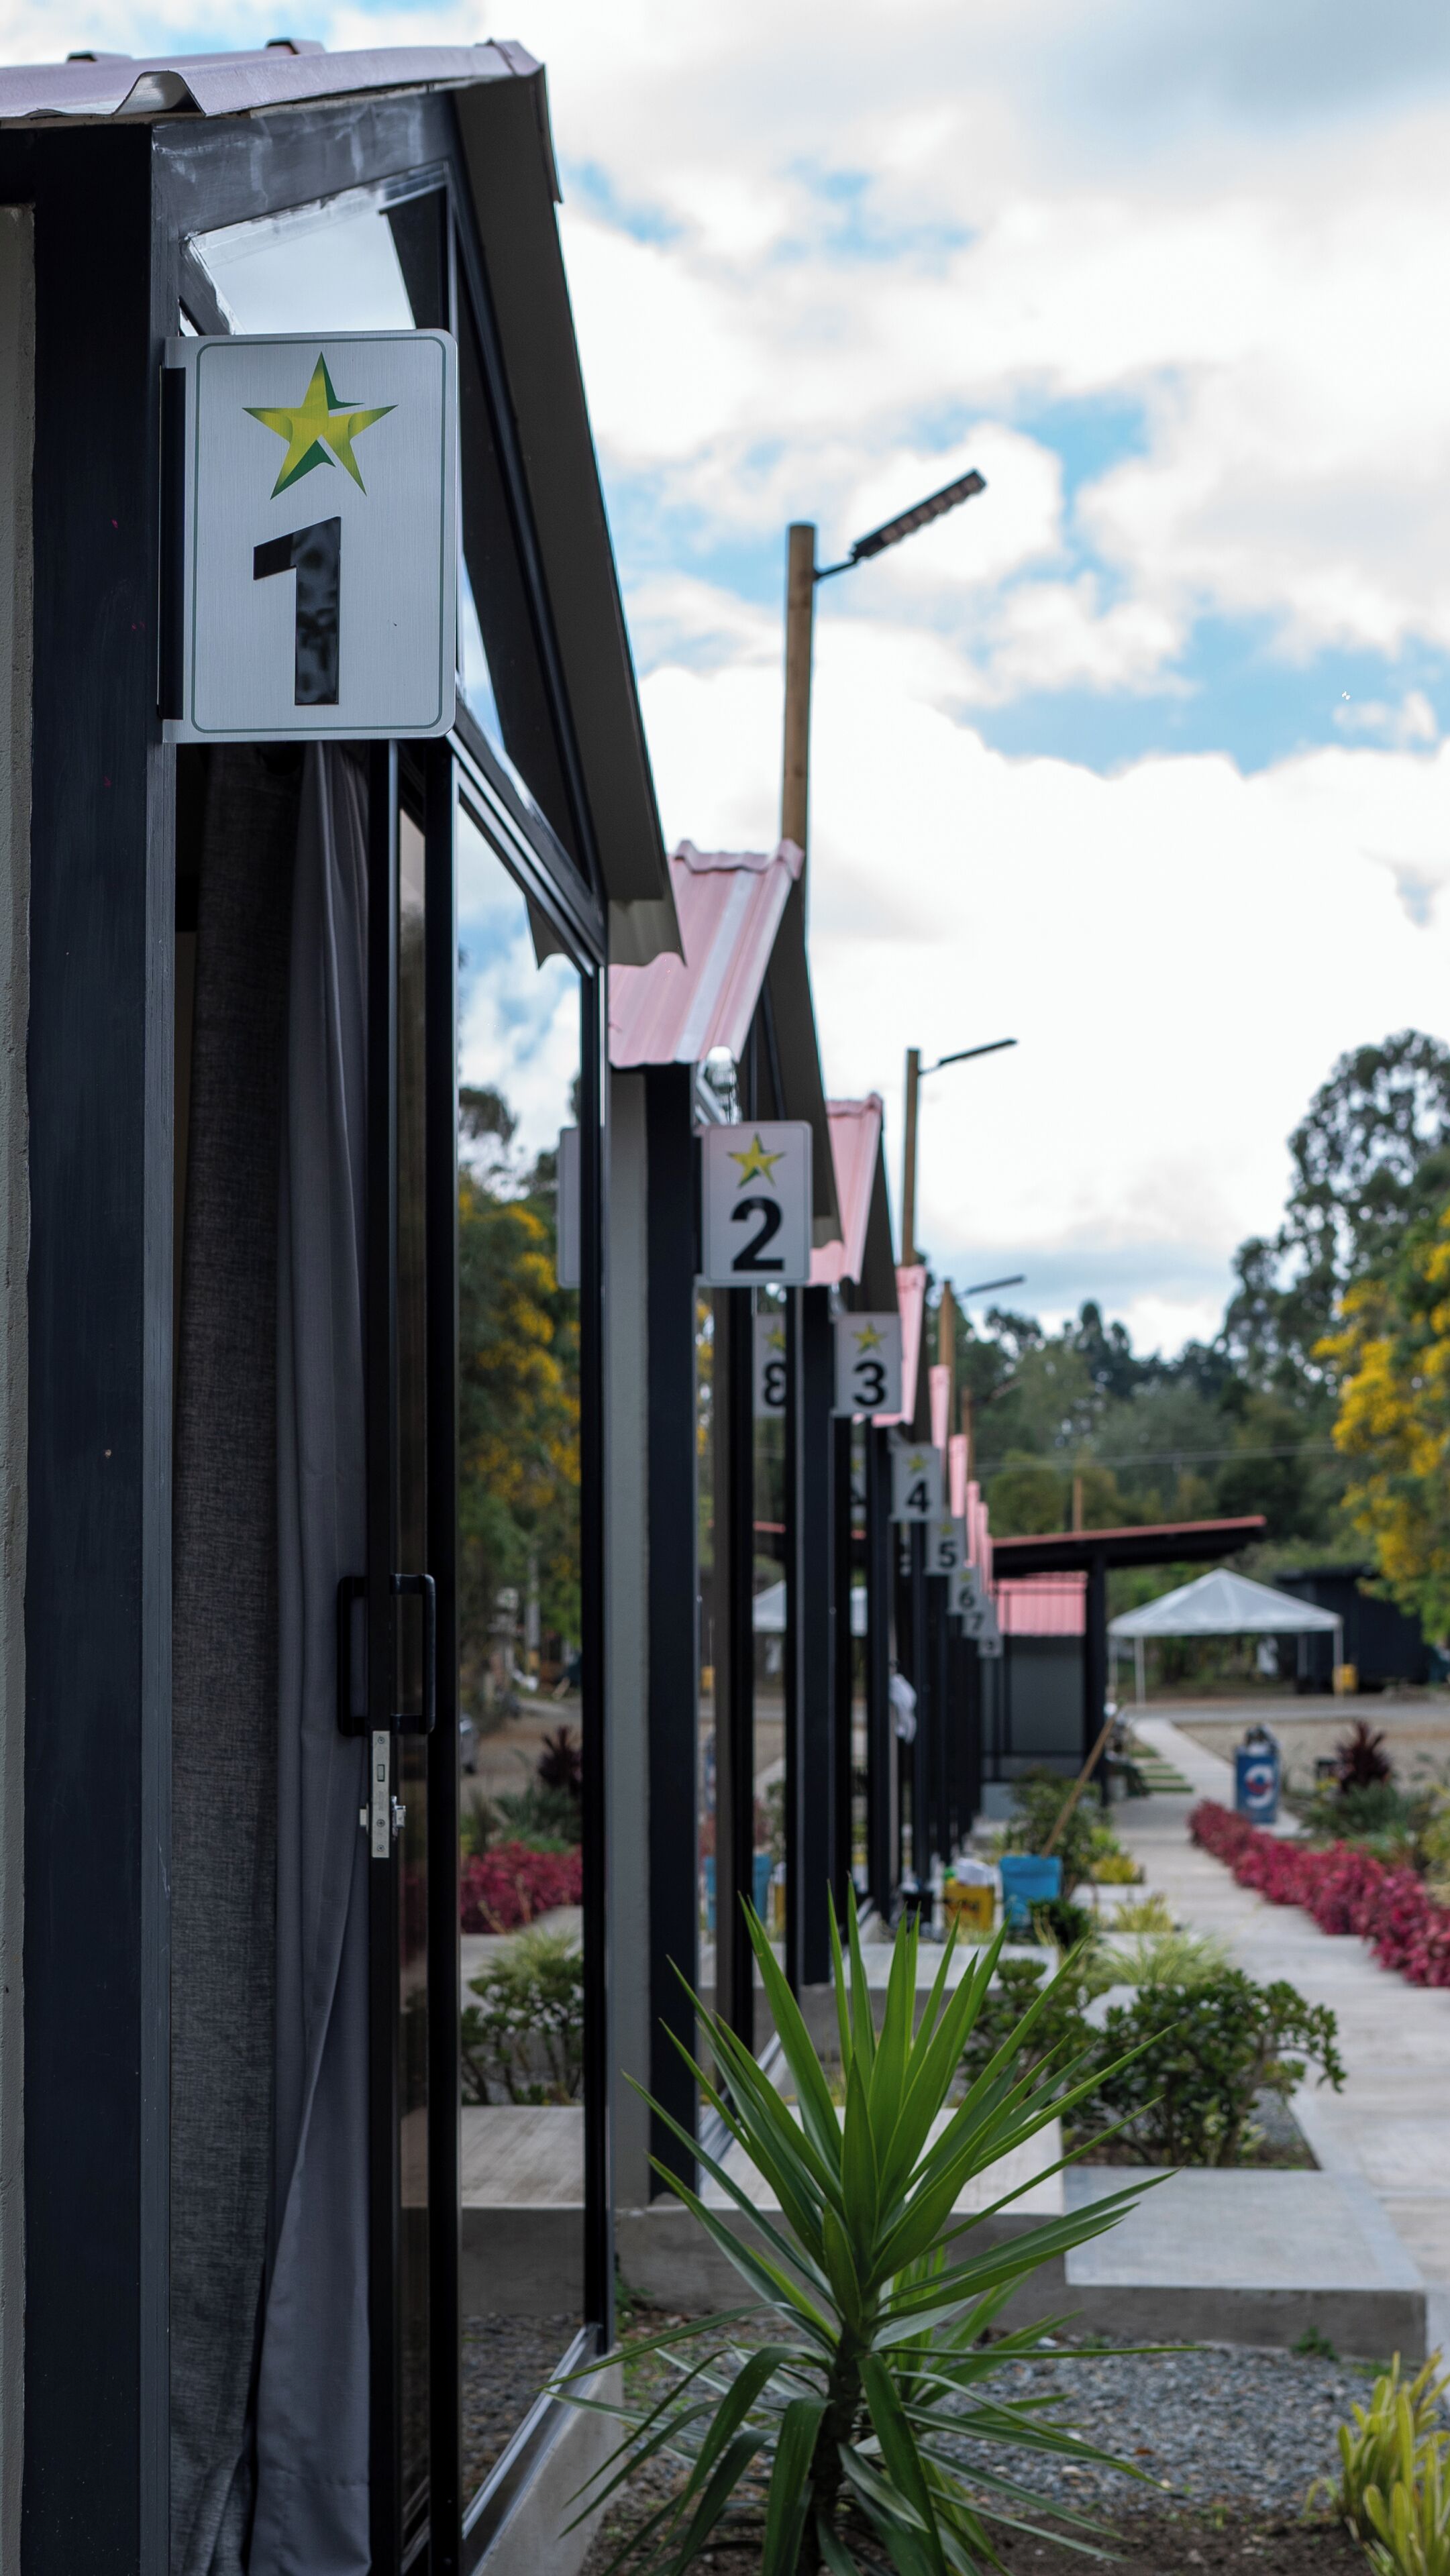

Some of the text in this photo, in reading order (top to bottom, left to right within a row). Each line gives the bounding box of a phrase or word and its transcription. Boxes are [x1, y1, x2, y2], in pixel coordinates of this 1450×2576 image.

[253, 516, 341, 706] 1
[731, 1195, 785, 1272] 2
[853, 1360, 886, 1407] 3
[908, 1479, 930, 1513] 4
[939, 1540, 957, 1568] 5
[960, 1585, 976, 1609] 6
